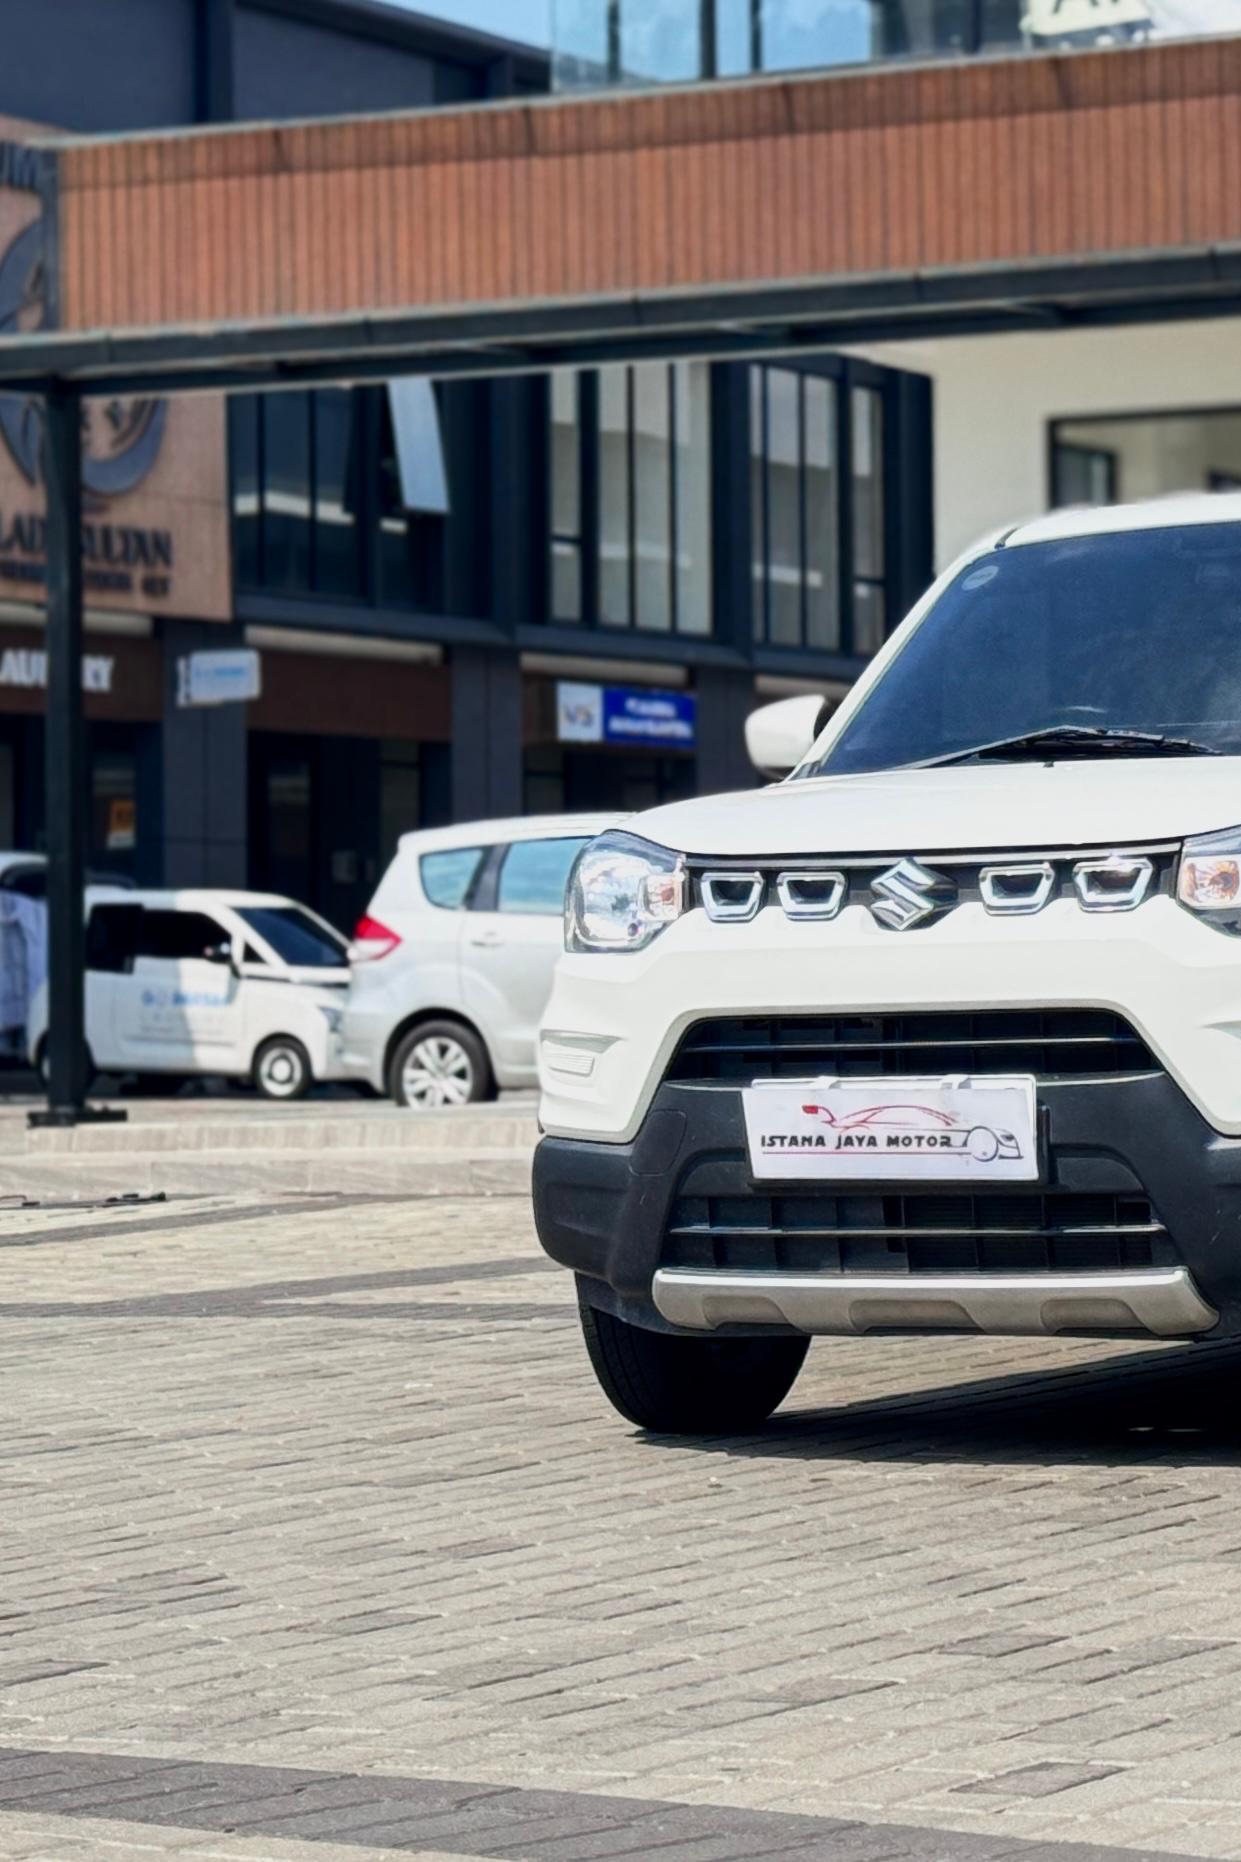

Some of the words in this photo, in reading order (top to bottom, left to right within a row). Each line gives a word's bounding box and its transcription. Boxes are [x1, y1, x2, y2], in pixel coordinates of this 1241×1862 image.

[760, 1134, 827, 1148] ISTANA
[834, 1134, 879, 1150] JAYA
[886, 1134, 952, 1148] MOTOR
